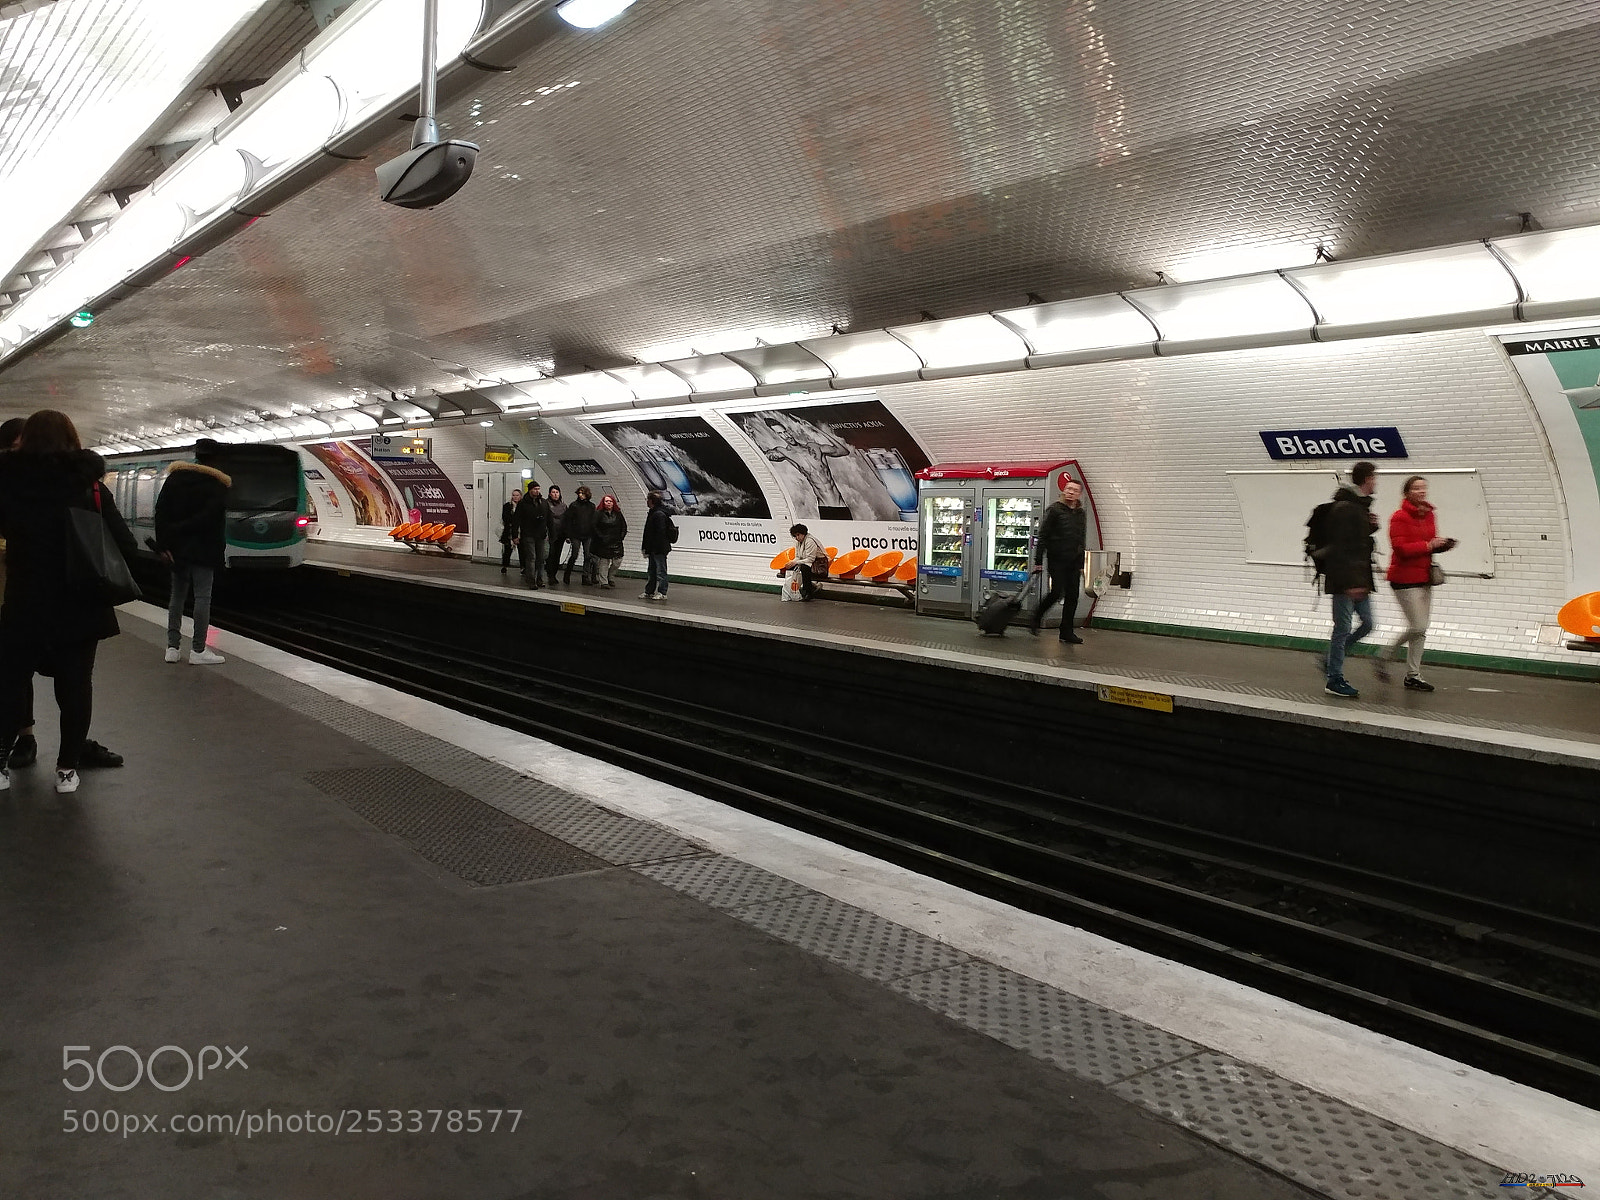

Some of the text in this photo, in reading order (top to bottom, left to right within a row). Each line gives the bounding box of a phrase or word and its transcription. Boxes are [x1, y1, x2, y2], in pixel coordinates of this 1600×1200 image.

[1525, 338, 1590, 352] MAIRIE
[829, 421, 862, 430] INVICTUS
[1275, 434, 1387, 455] Blanche
[565, 462, 599, 474] Blanche
[699, 529, 777, 544] paco rabanne
[852, 536, 888, 550] paco
